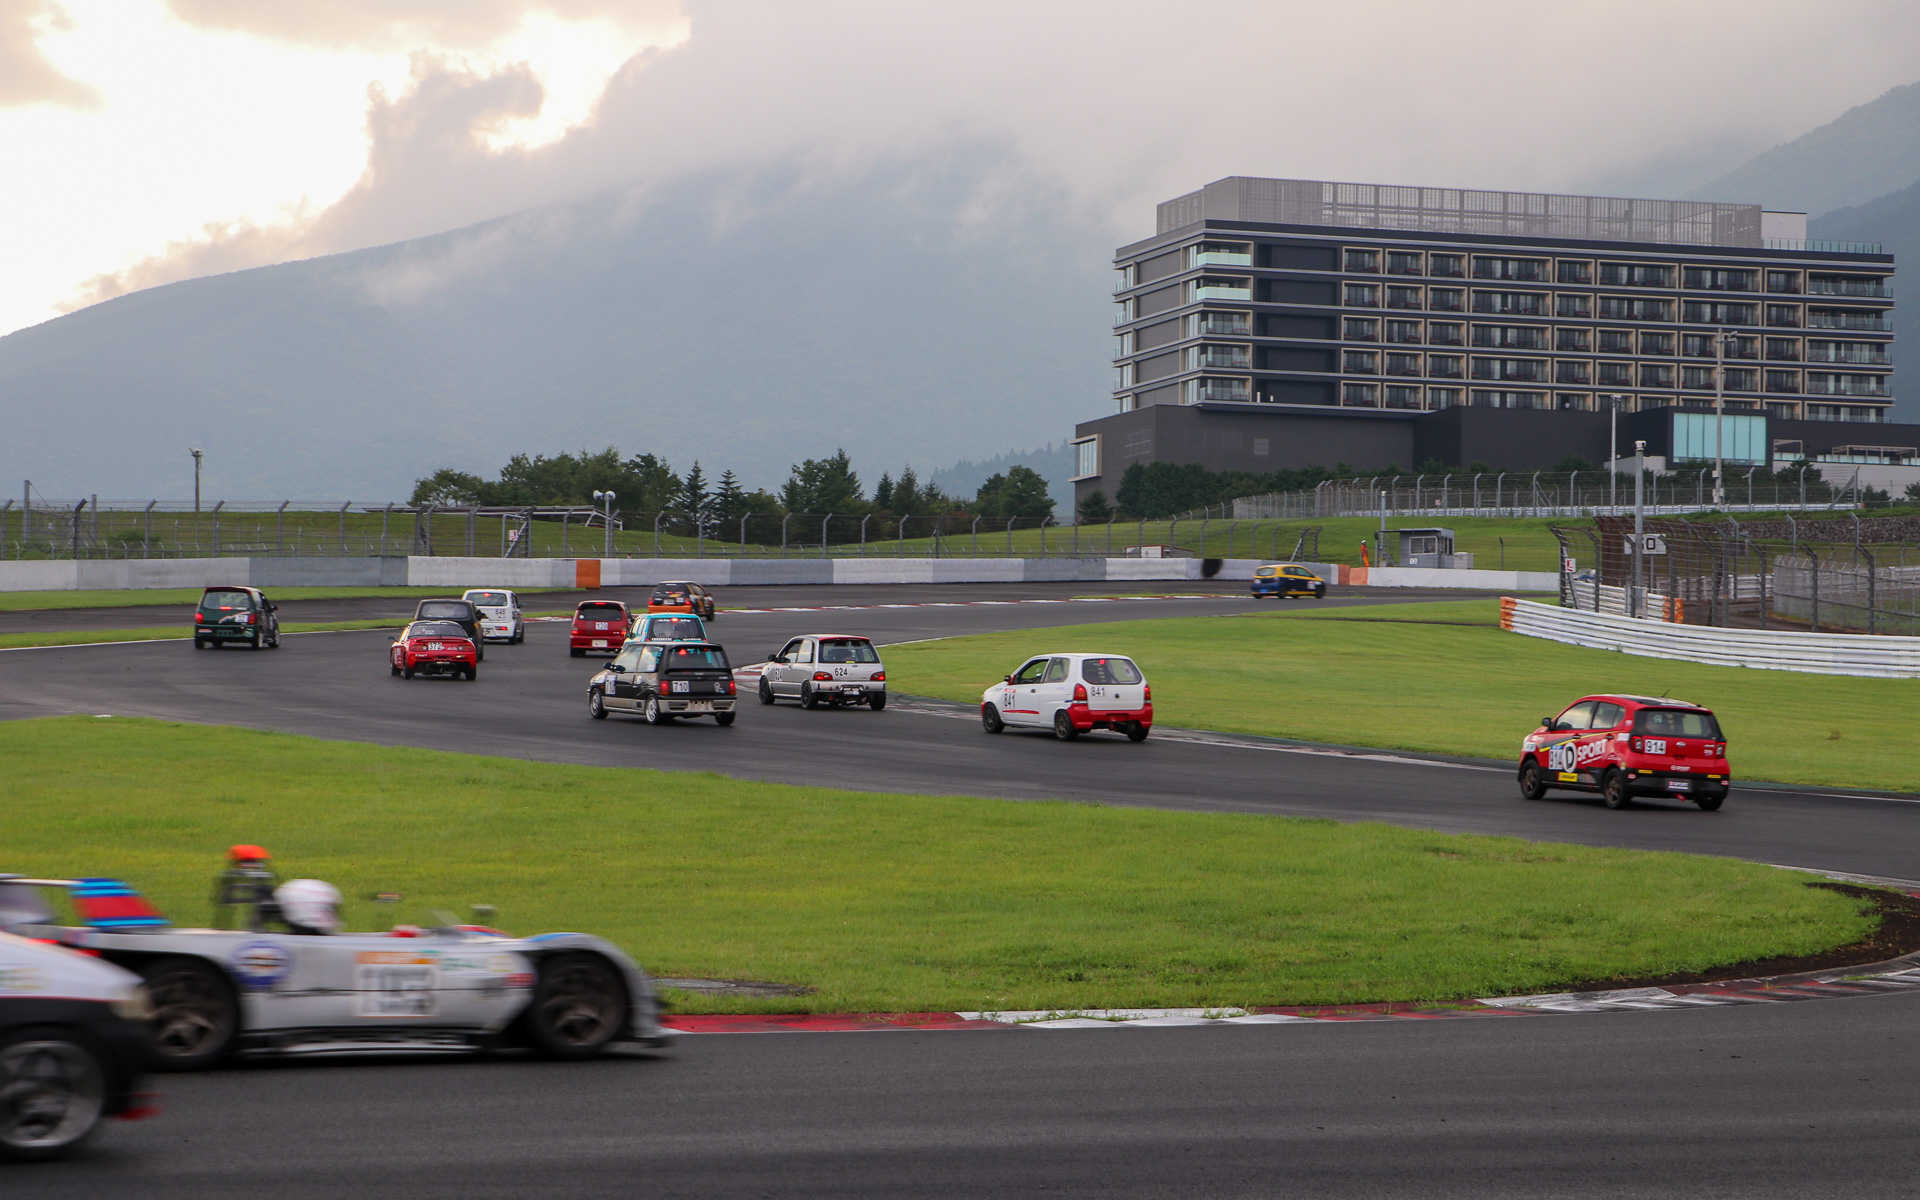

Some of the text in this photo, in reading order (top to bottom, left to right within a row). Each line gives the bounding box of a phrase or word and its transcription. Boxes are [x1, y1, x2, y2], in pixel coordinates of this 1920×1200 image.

[429, 642, 442, 650] 372
[834, 667, 848, 676] 624
[673, 682, 688, 692] 710
[1091, 686, 1105, 697] 841
[1004, 693, 1015, 708] 841
[1577, 739, 1608, 761] SPORT
[1646, 741, 1665, 753] 914
